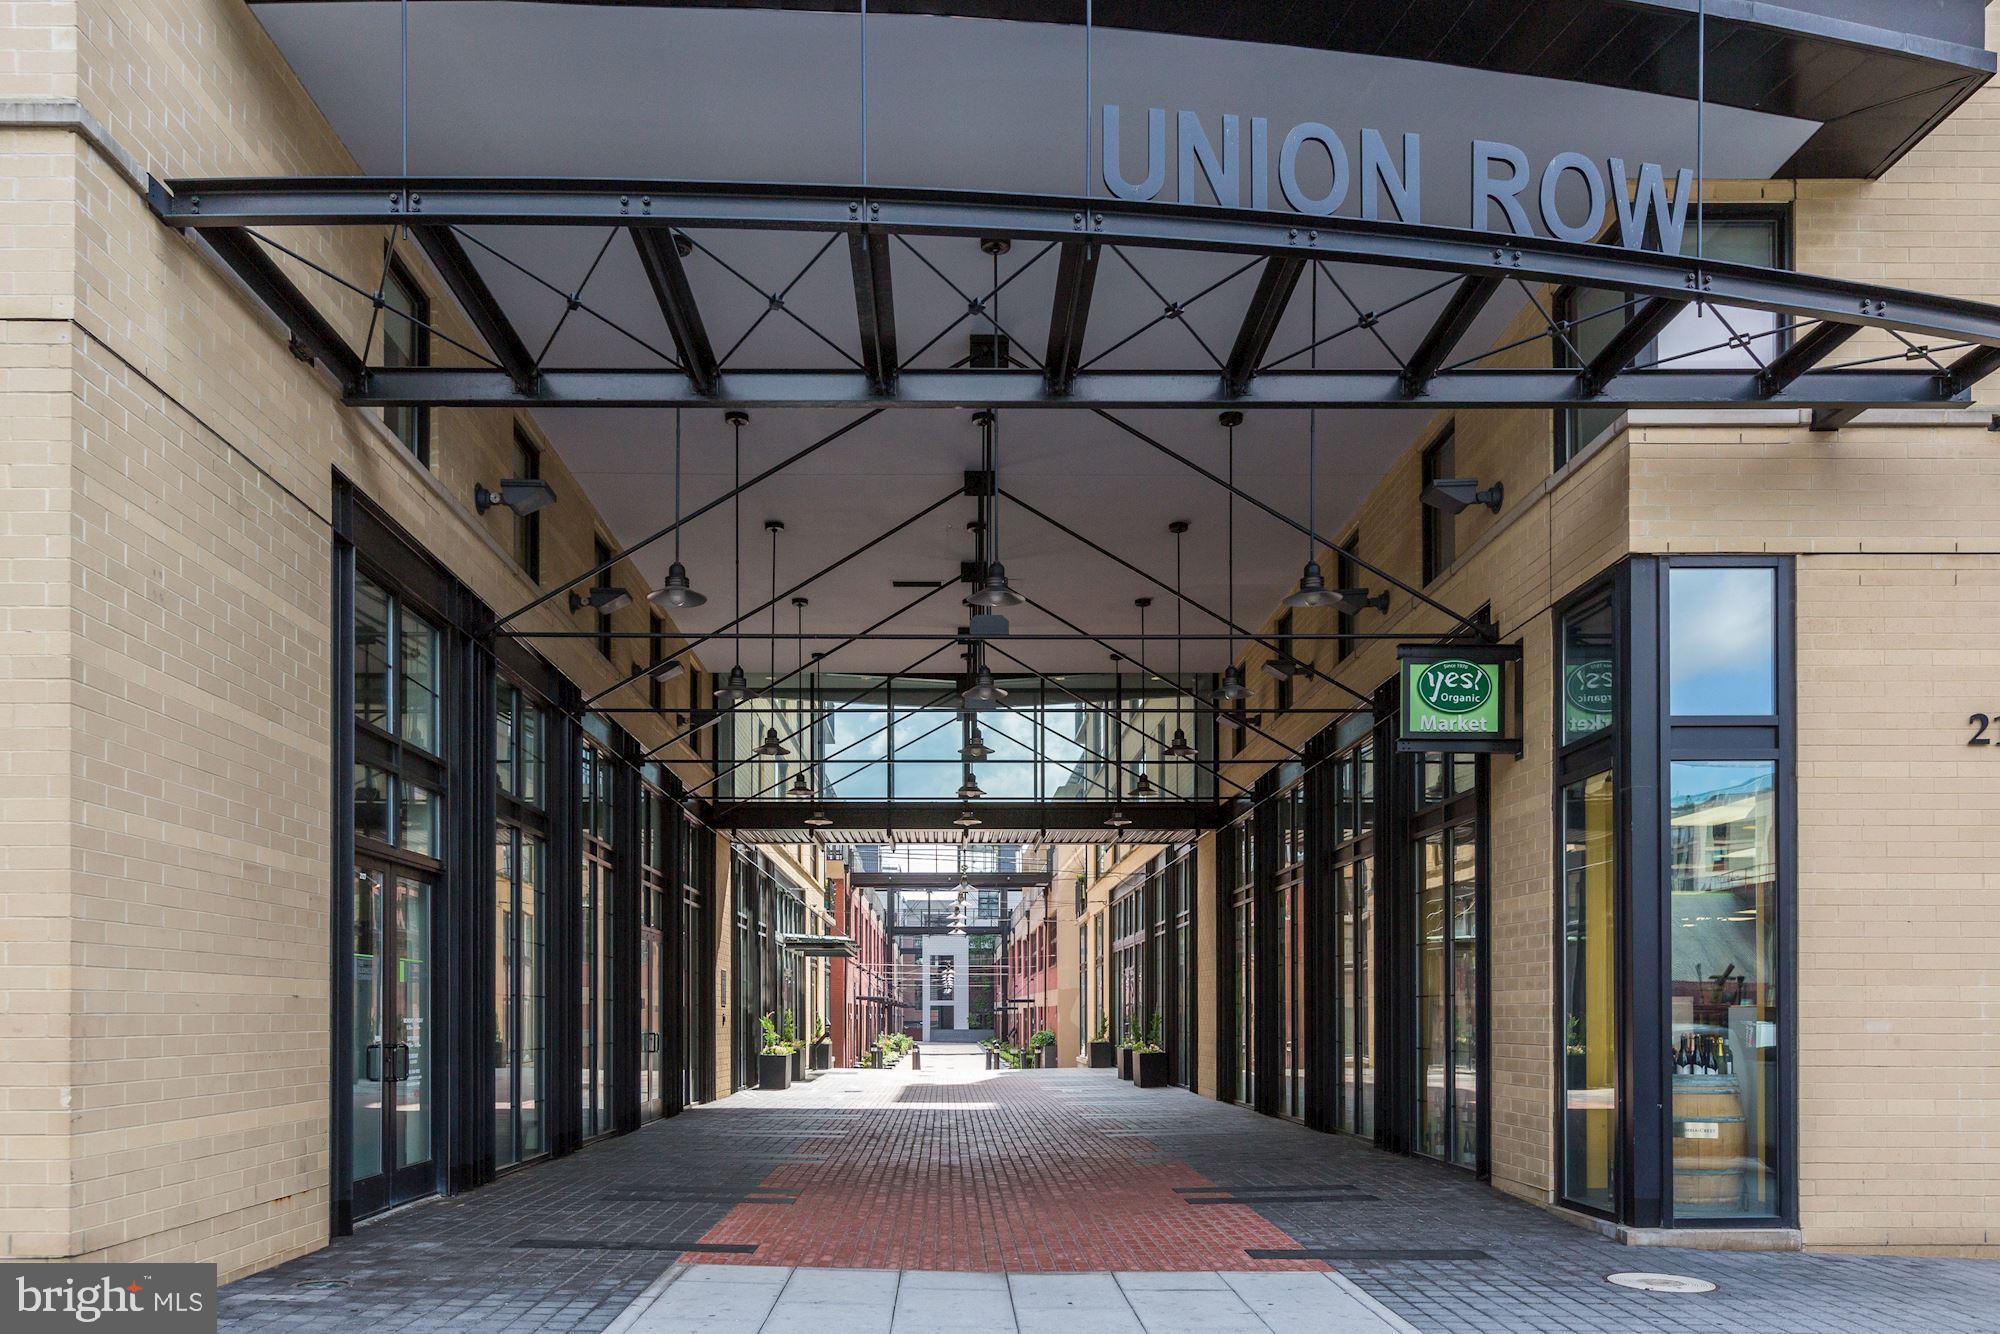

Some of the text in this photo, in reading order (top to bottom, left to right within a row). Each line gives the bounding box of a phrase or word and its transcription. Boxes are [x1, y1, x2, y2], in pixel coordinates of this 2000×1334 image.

[1102, 104, 1693, 255] UNION ROW
[1427, 669, 1483, 703] yes!
[1440, 692, 1480, 704] Organic
[1420, 714, 1488, 732] Market
